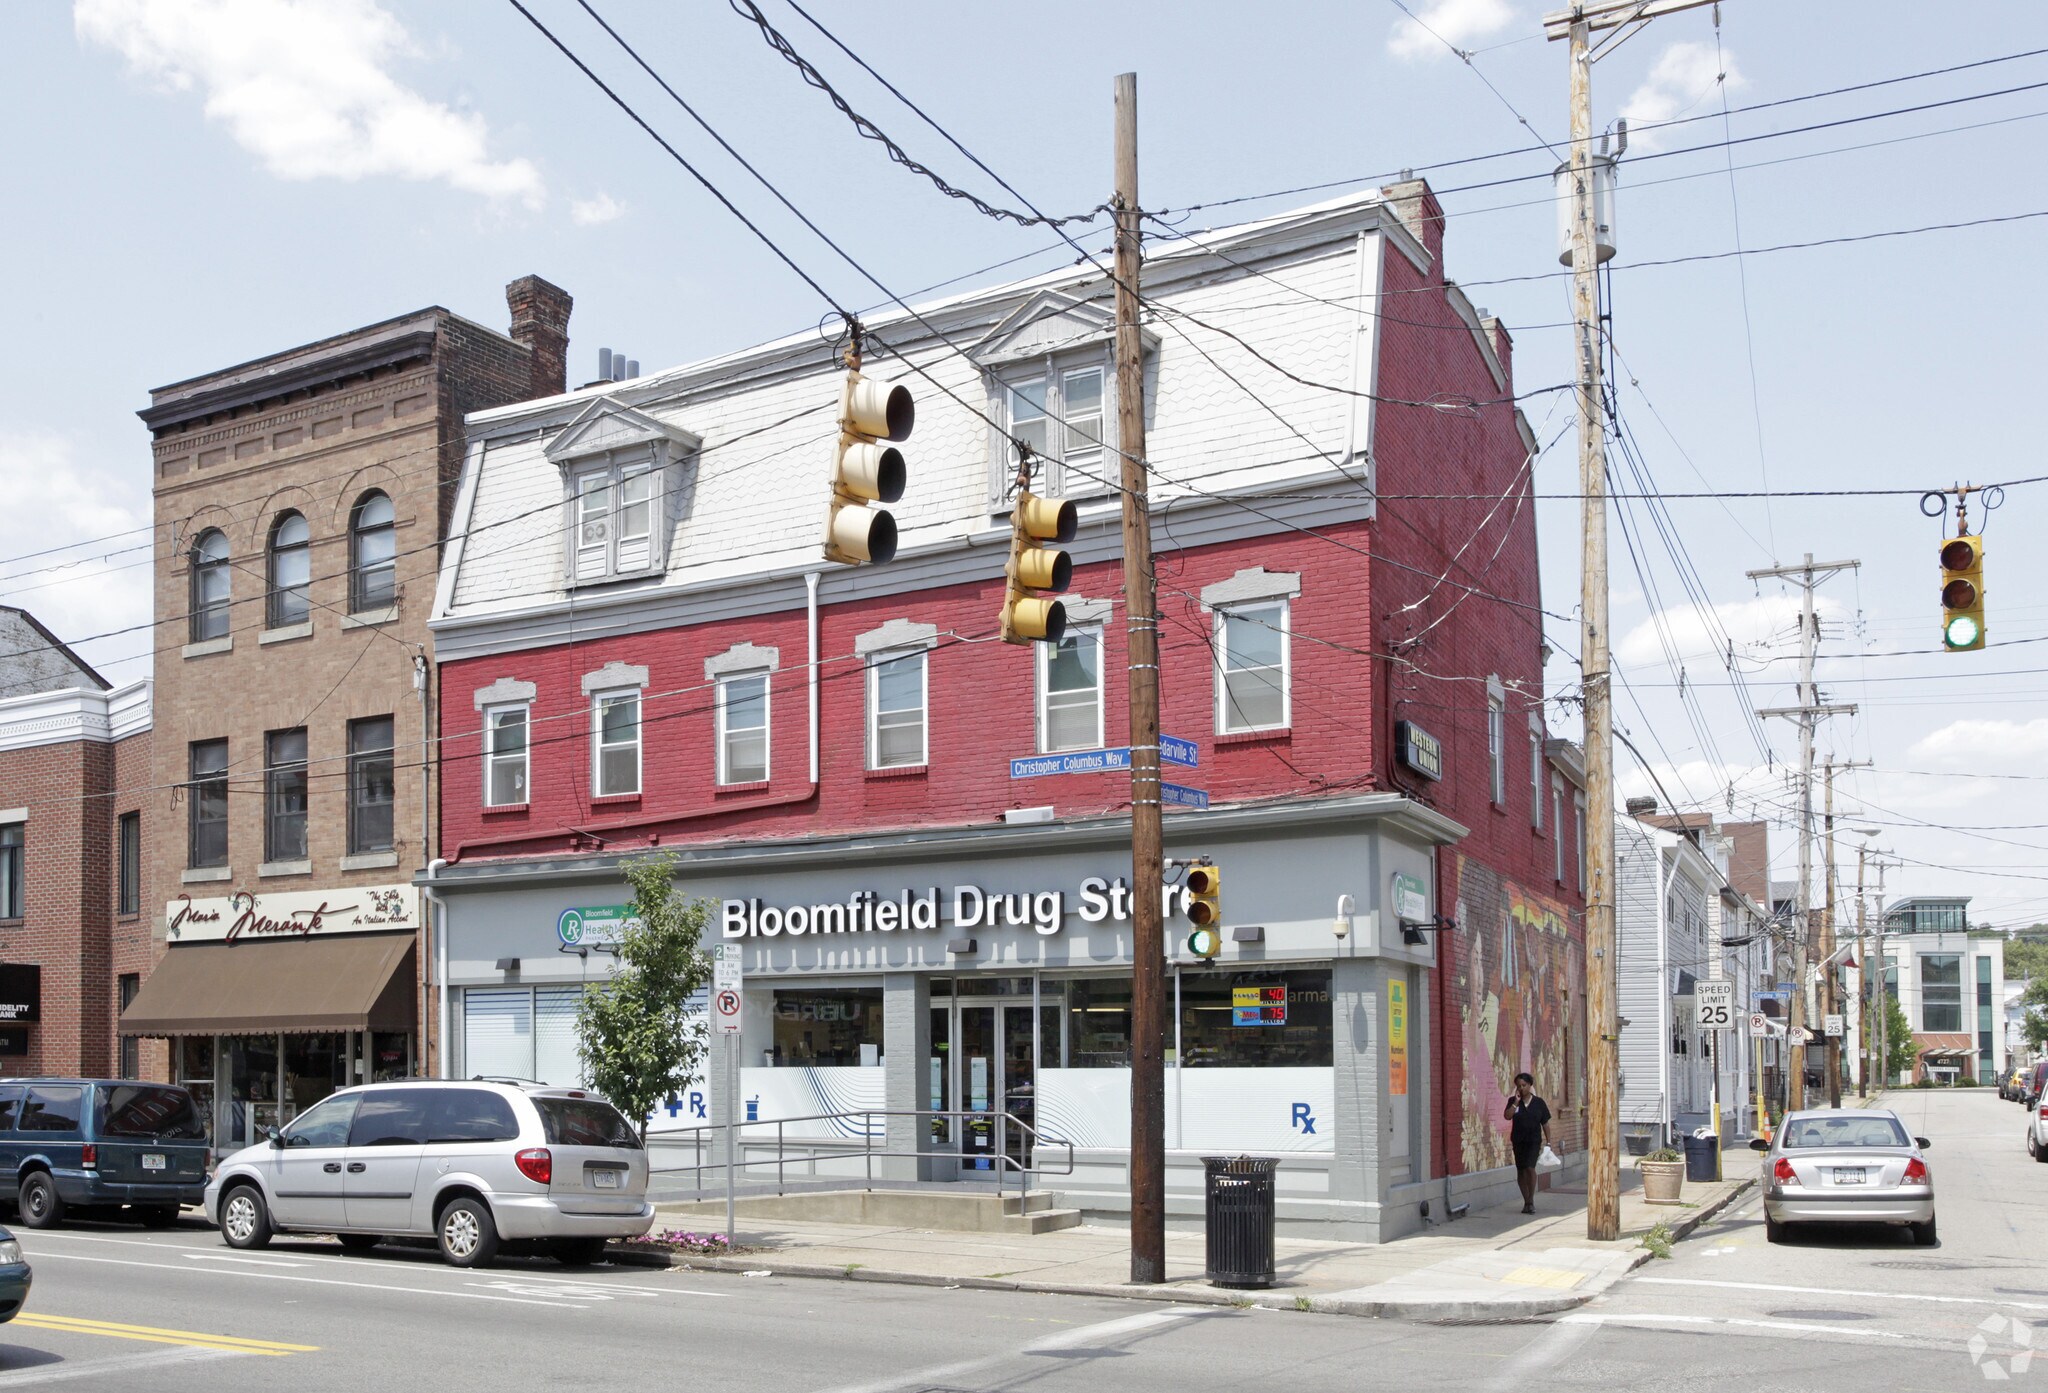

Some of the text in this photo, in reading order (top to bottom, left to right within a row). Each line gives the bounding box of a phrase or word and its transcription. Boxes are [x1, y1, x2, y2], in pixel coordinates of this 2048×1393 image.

[1411, 726, 1437, 758] WESTERN
[1159, 740, 1197, 763] edarville St
[1015, 753, 1123, 775] Christopher Columbus Way
[1418, 749, 1438, 775] UNION
[1180, 789, 1198, 805] Columbus
[383, 889, 399, 901] Shop
[375, 900, 389, 912] with
[722, 886, 939, 938] Bloomfield
[954, 884, 1063, 935] Drug
[171, 892, 359, 943] Maria Merante
[585, 909, 613, 917] Bloomfield
[352, 915, 362, 925] An
[364, 914, 385, 924] Italian
[715, 946, 723, 959] 2
[1268, 988, 1284, 1001] 40
[1698, 985, 1731, 994] SPEED
[1702, 996, 1726, 1004] LIMIT
[0, 1004, 29, 1012] IDELITY
[1270, 1007, 1284, 1019] 75
[1702, 1006, 1728, 1024] 25
[1828, 1026, 1840, 1034] 25
[0, 1038, 9, 1046] TM
